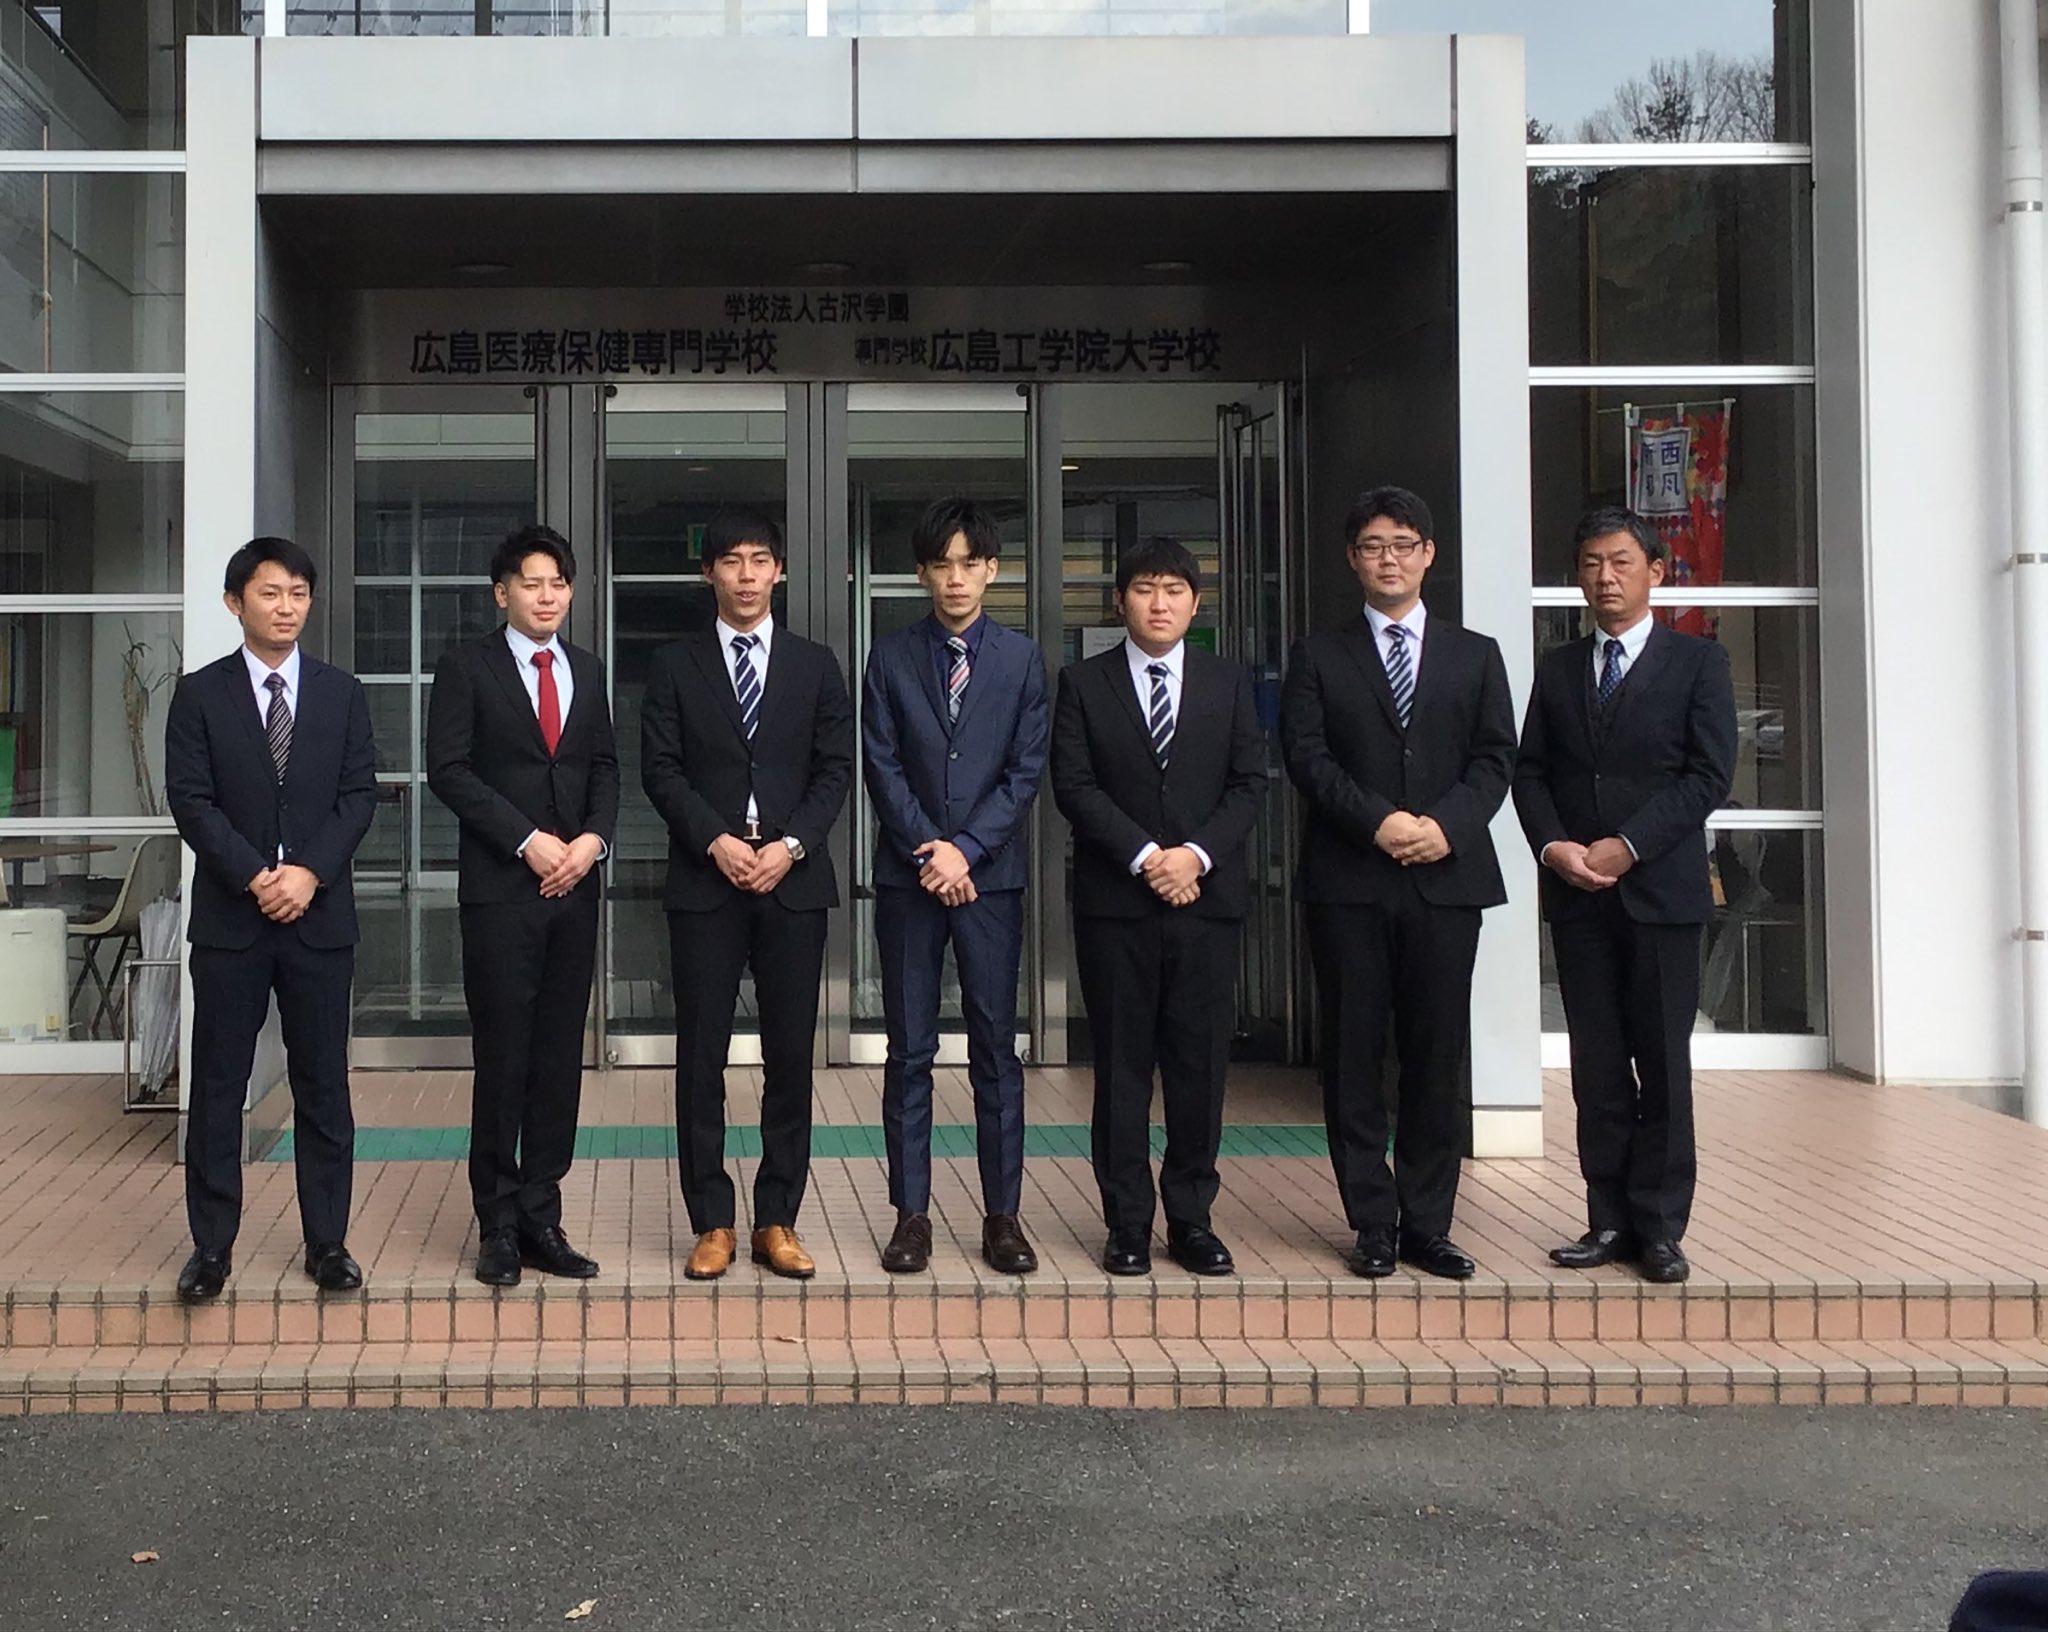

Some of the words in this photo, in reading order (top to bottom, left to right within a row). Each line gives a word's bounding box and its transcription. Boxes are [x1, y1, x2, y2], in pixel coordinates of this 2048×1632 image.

[410, 329, 778, 375] 広島医療保健専門学校
